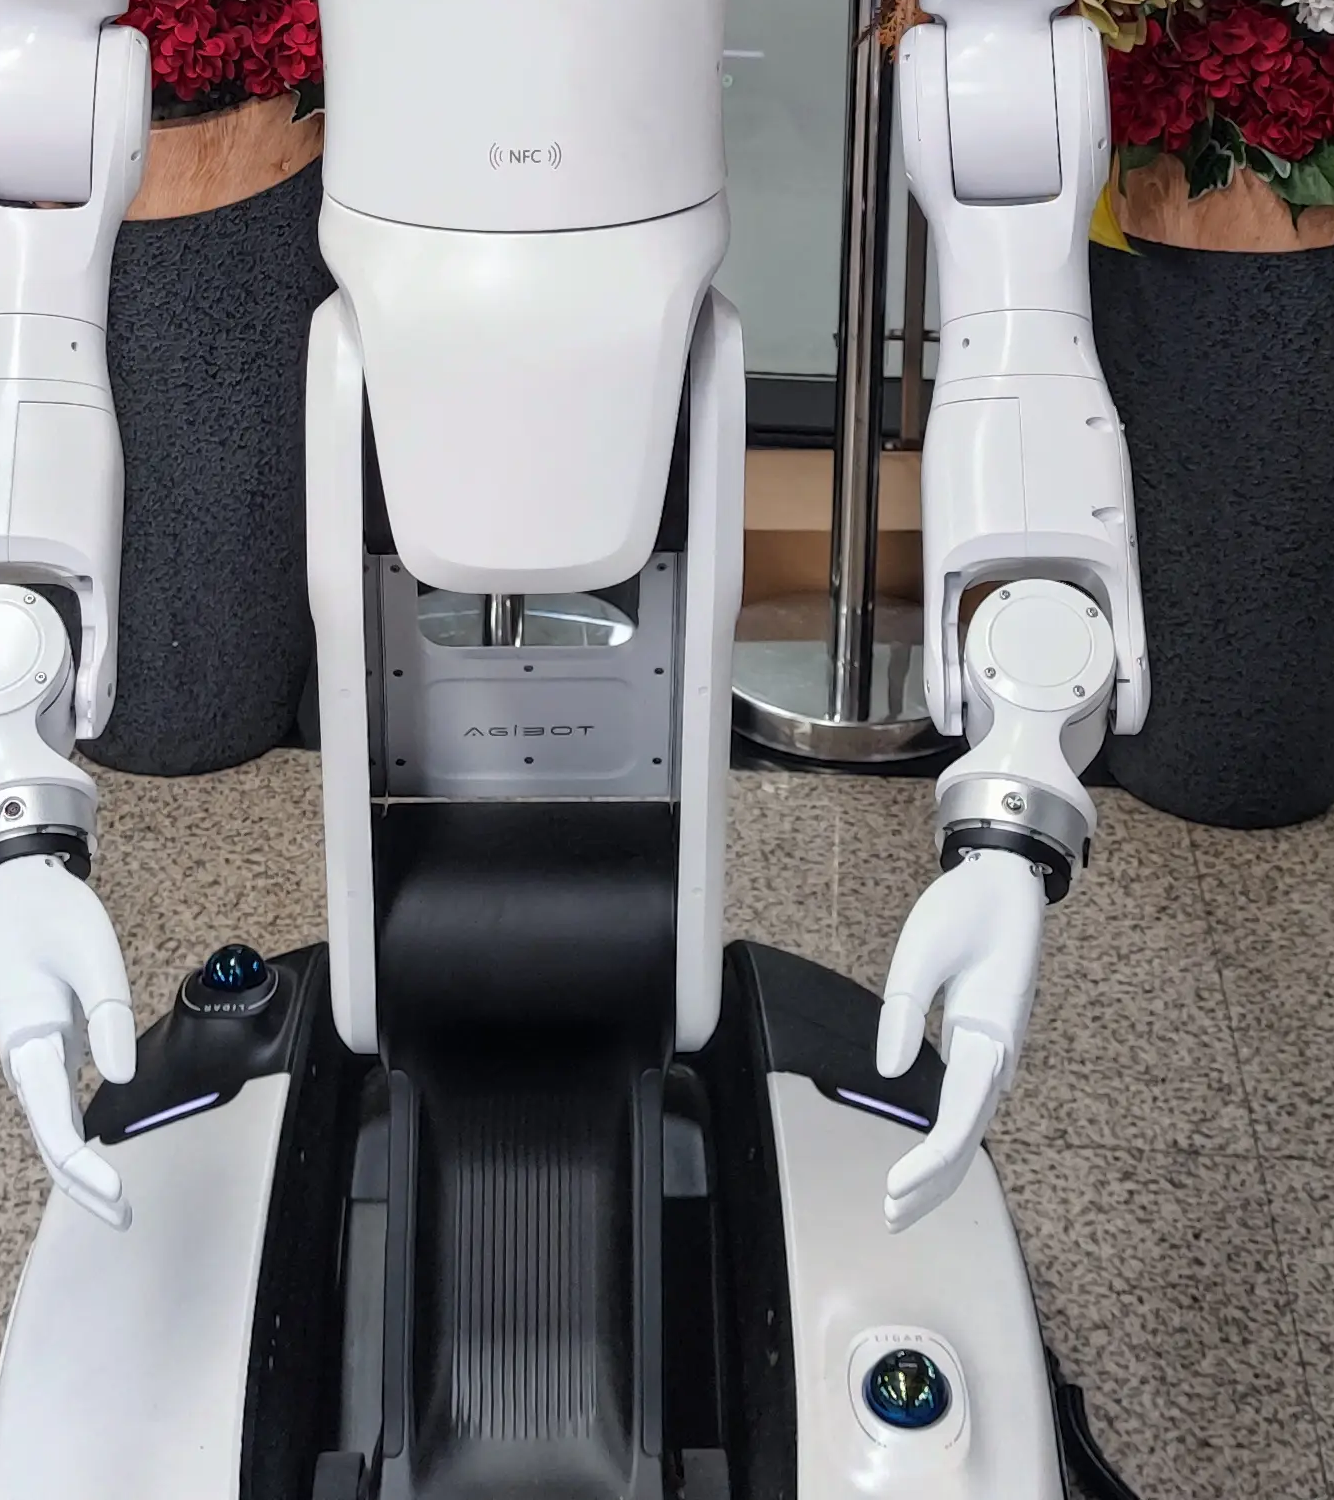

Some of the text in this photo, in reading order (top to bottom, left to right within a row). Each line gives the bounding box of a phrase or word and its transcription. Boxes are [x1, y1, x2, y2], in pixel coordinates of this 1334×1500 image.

[509, 149, 542, 164] NFC
[464, 724, 595, 737] AGIBOT
[204, 1003, 245, 1013] LIDAR
